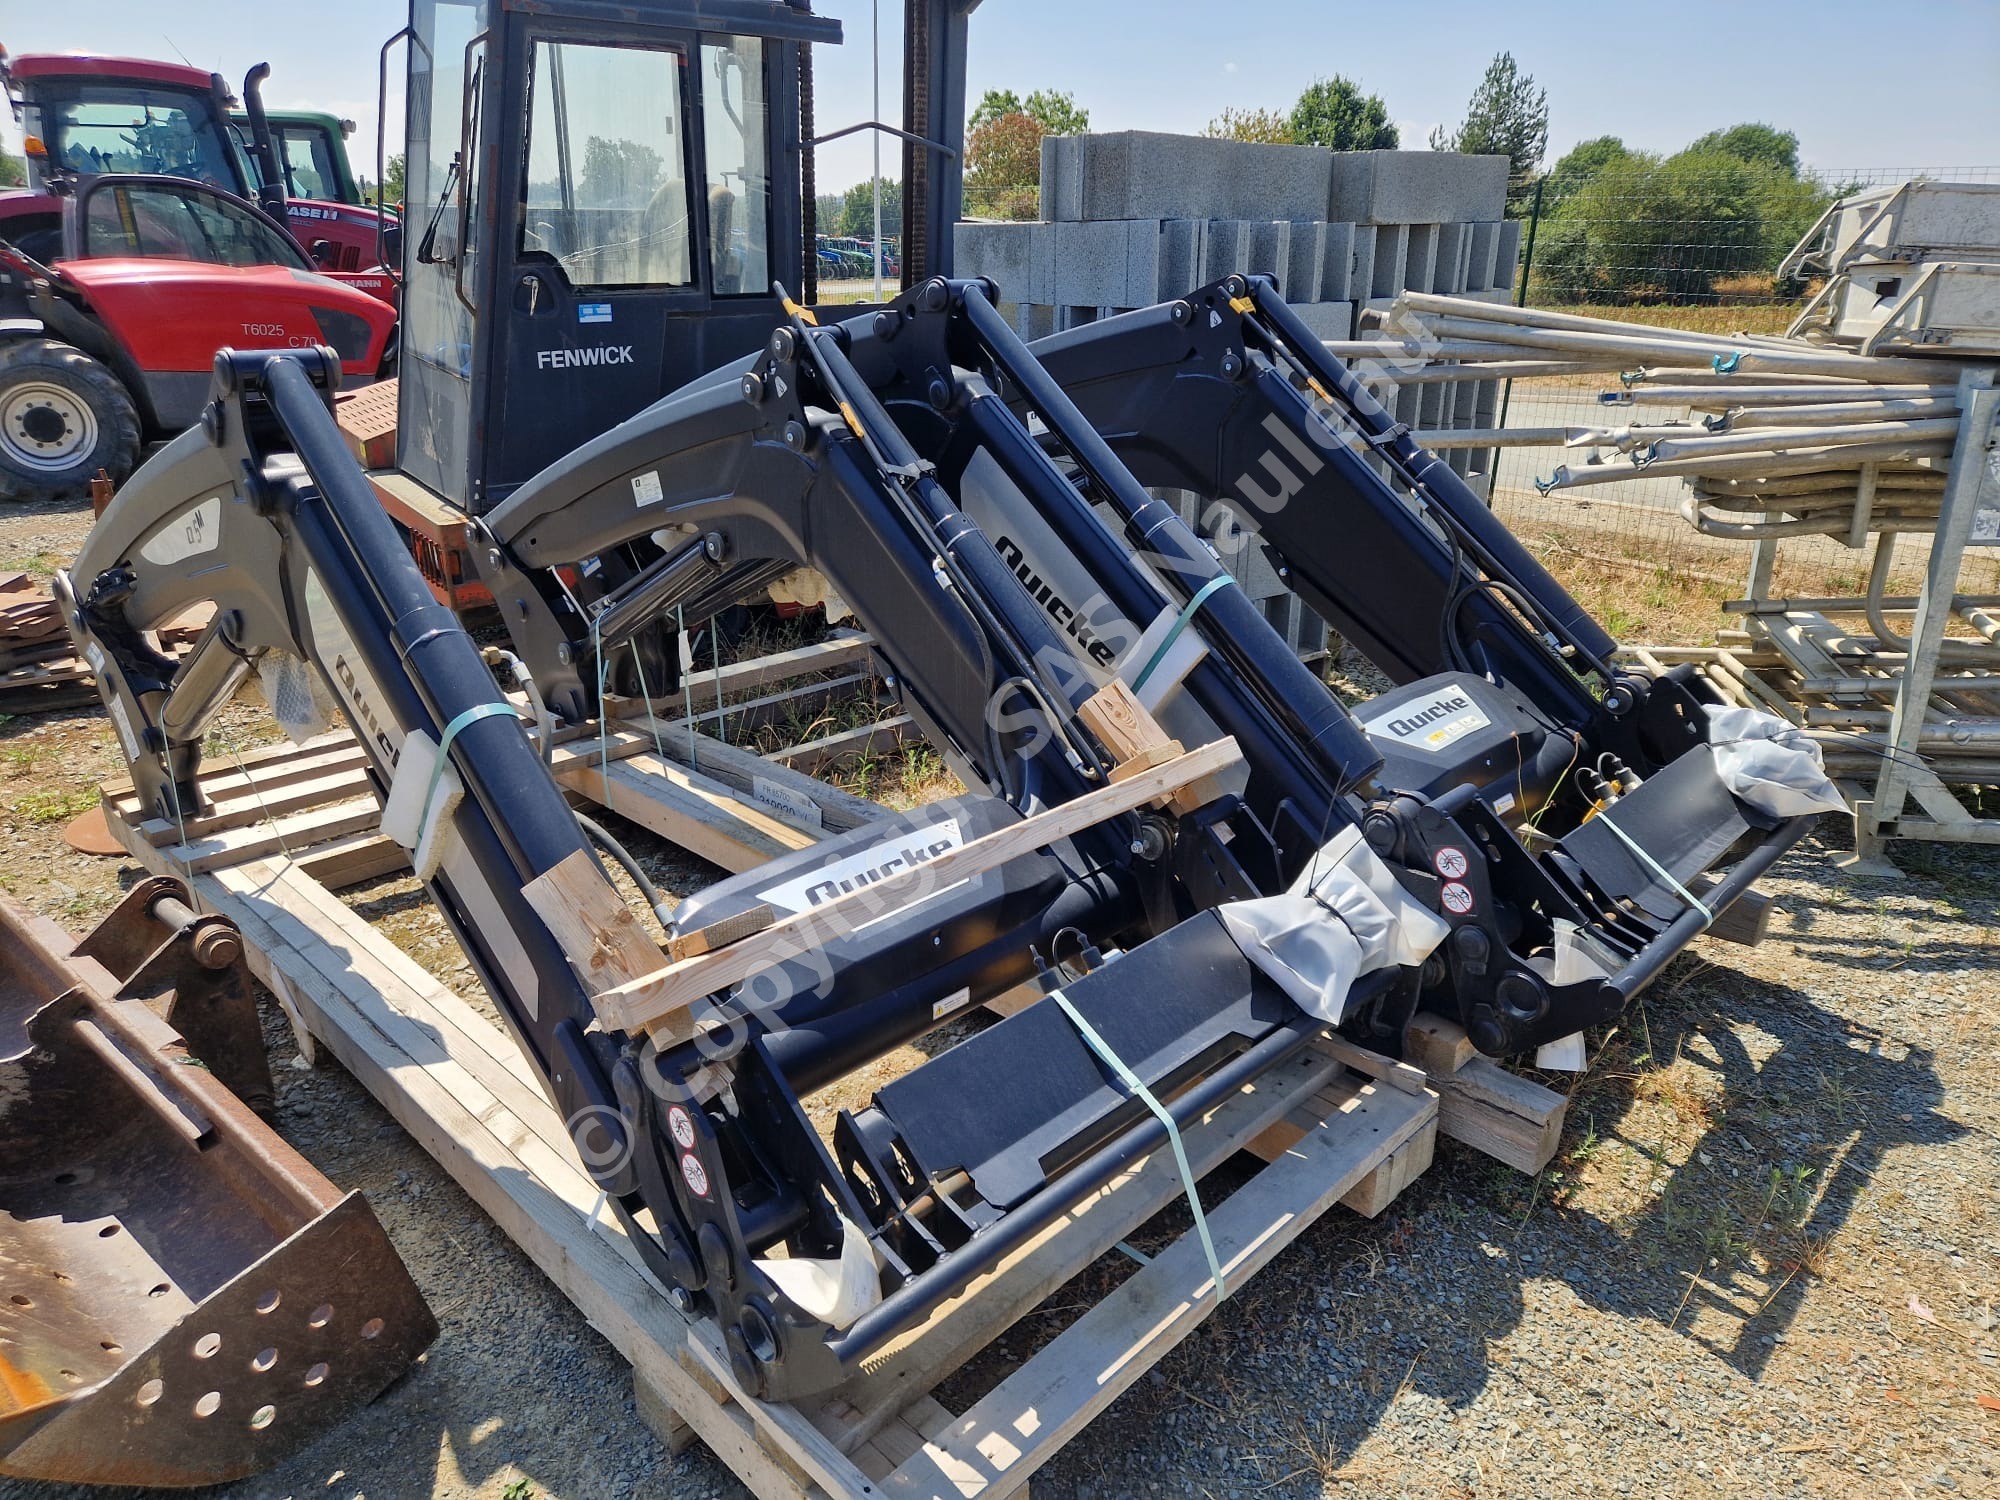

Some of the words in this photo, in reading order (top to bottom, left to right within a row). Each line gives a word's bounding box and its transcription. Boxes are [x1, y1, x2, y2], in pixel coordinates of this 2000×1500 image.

[286, 206, 321, 218] ASE
[240, 323, 285, 337] T6025
[537, 345, 634, 369] FENWICK
[994, 535, 1117, 668] Quicke
[335, 653, 402, 769] Quic
[1386, 697, 1470, 738] Quicke
